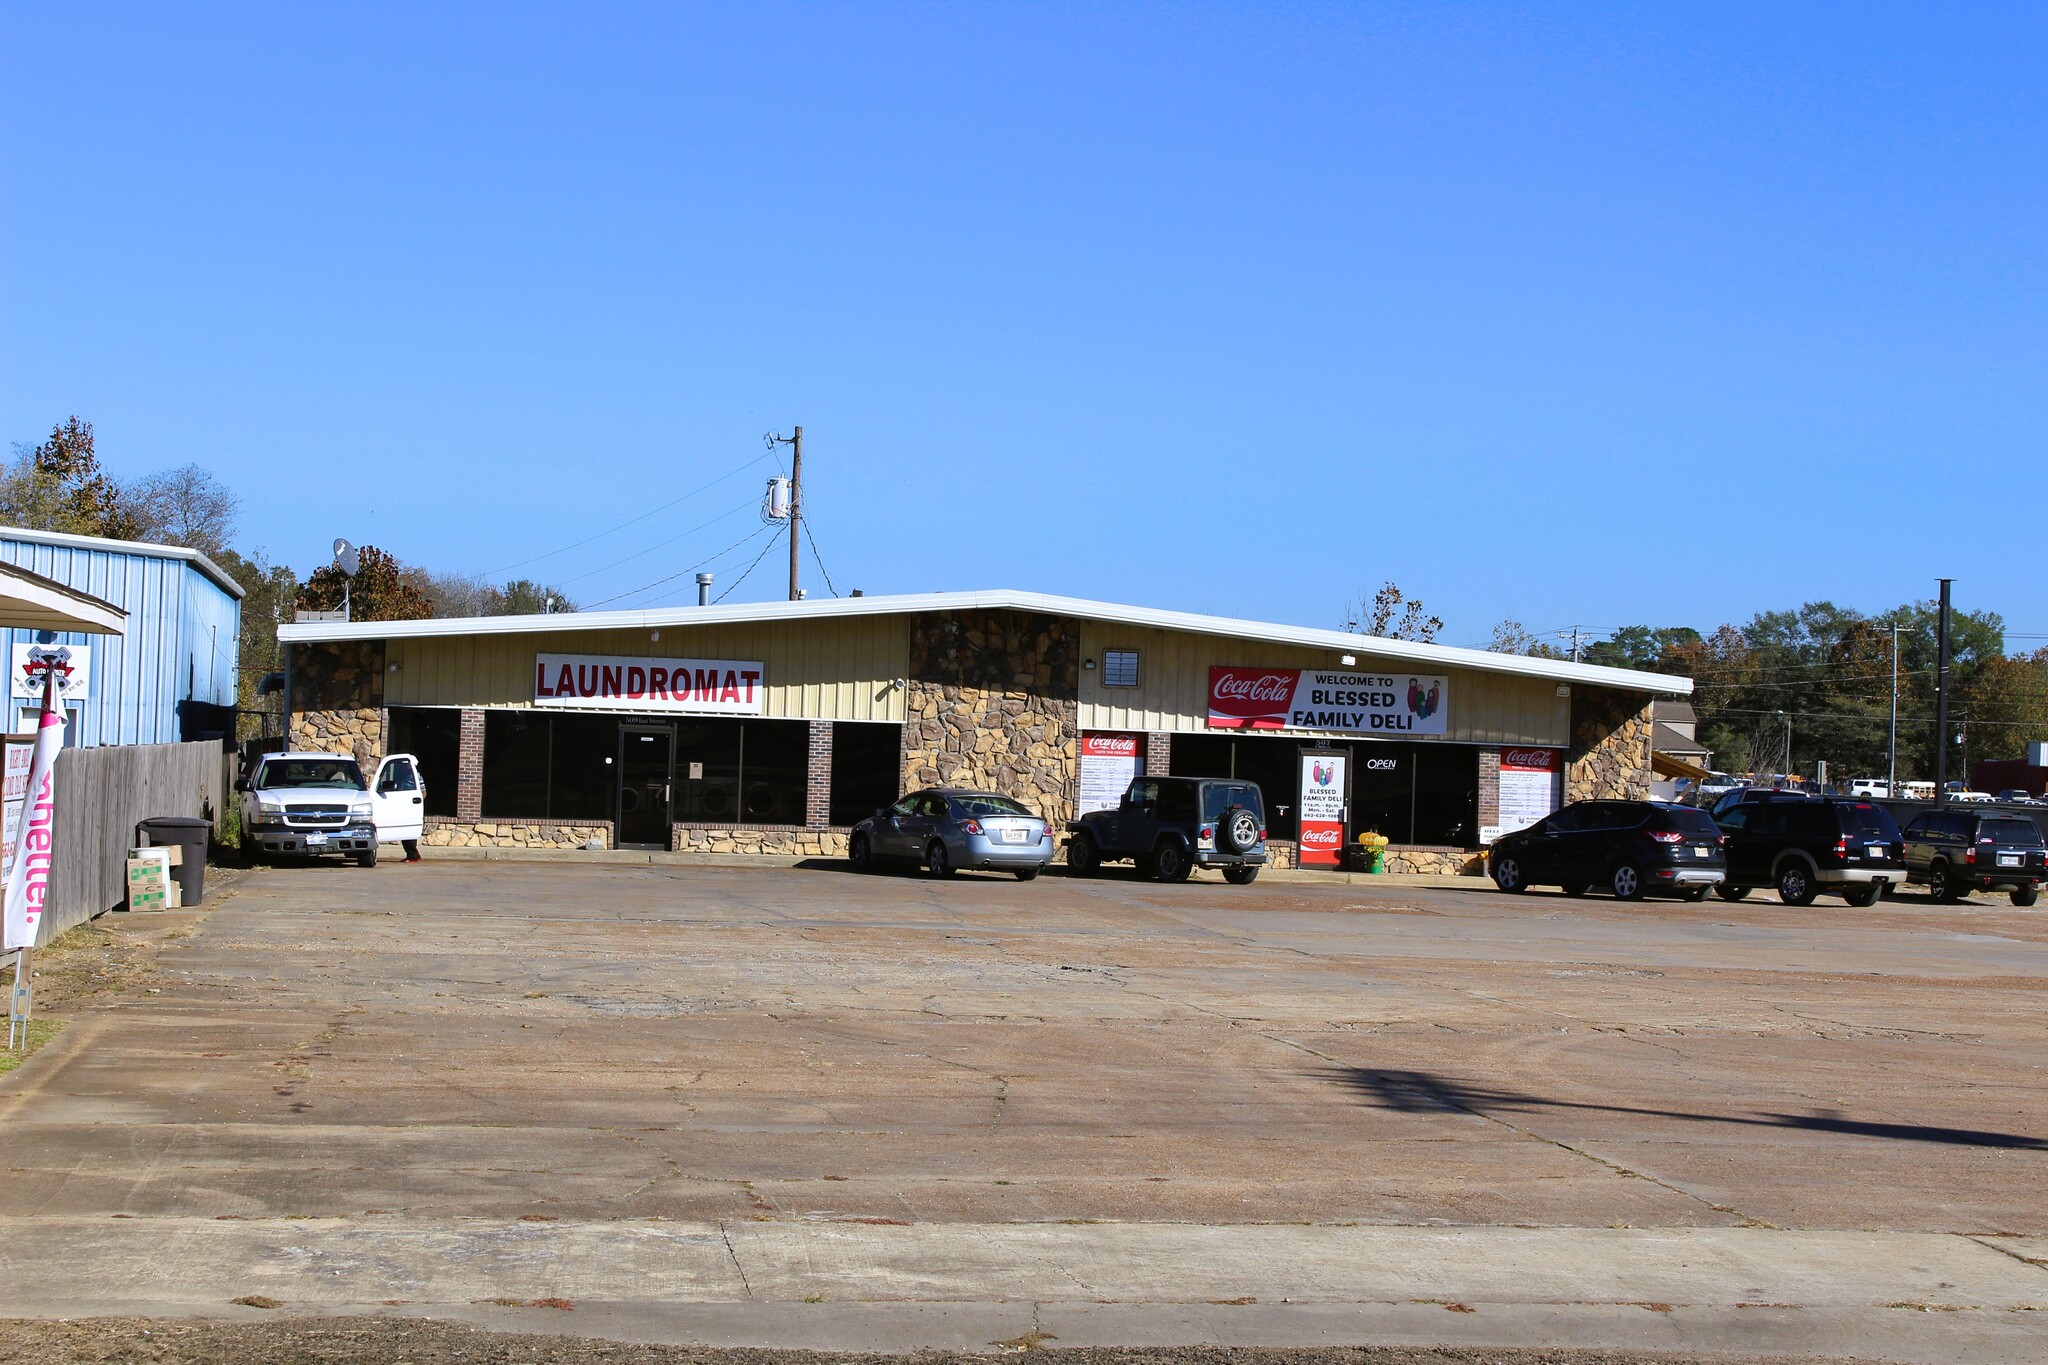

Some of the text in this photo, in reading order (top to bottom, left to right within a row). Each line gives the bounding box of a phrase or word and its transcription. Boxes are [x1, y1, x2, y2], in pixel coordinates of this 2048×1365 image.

[537, 663, 760, 704] LAUNDROMAT
[1213, 673, 1293, 702] Coca-Cola
[1315, 674, 1393, 687] WELCOME TO
[1311, 689, 1396, 708] BLESSED
[1293, 710, 1412, 730] FAMILY DELI
[1089, 734, 1137, 751] Coca-Cola
[1367, 759, 1397, 769] OPEN
[1506, 749, 1552, 766] Coca-Cola
[1302, 829, 1340, 843] Coca-Cola
